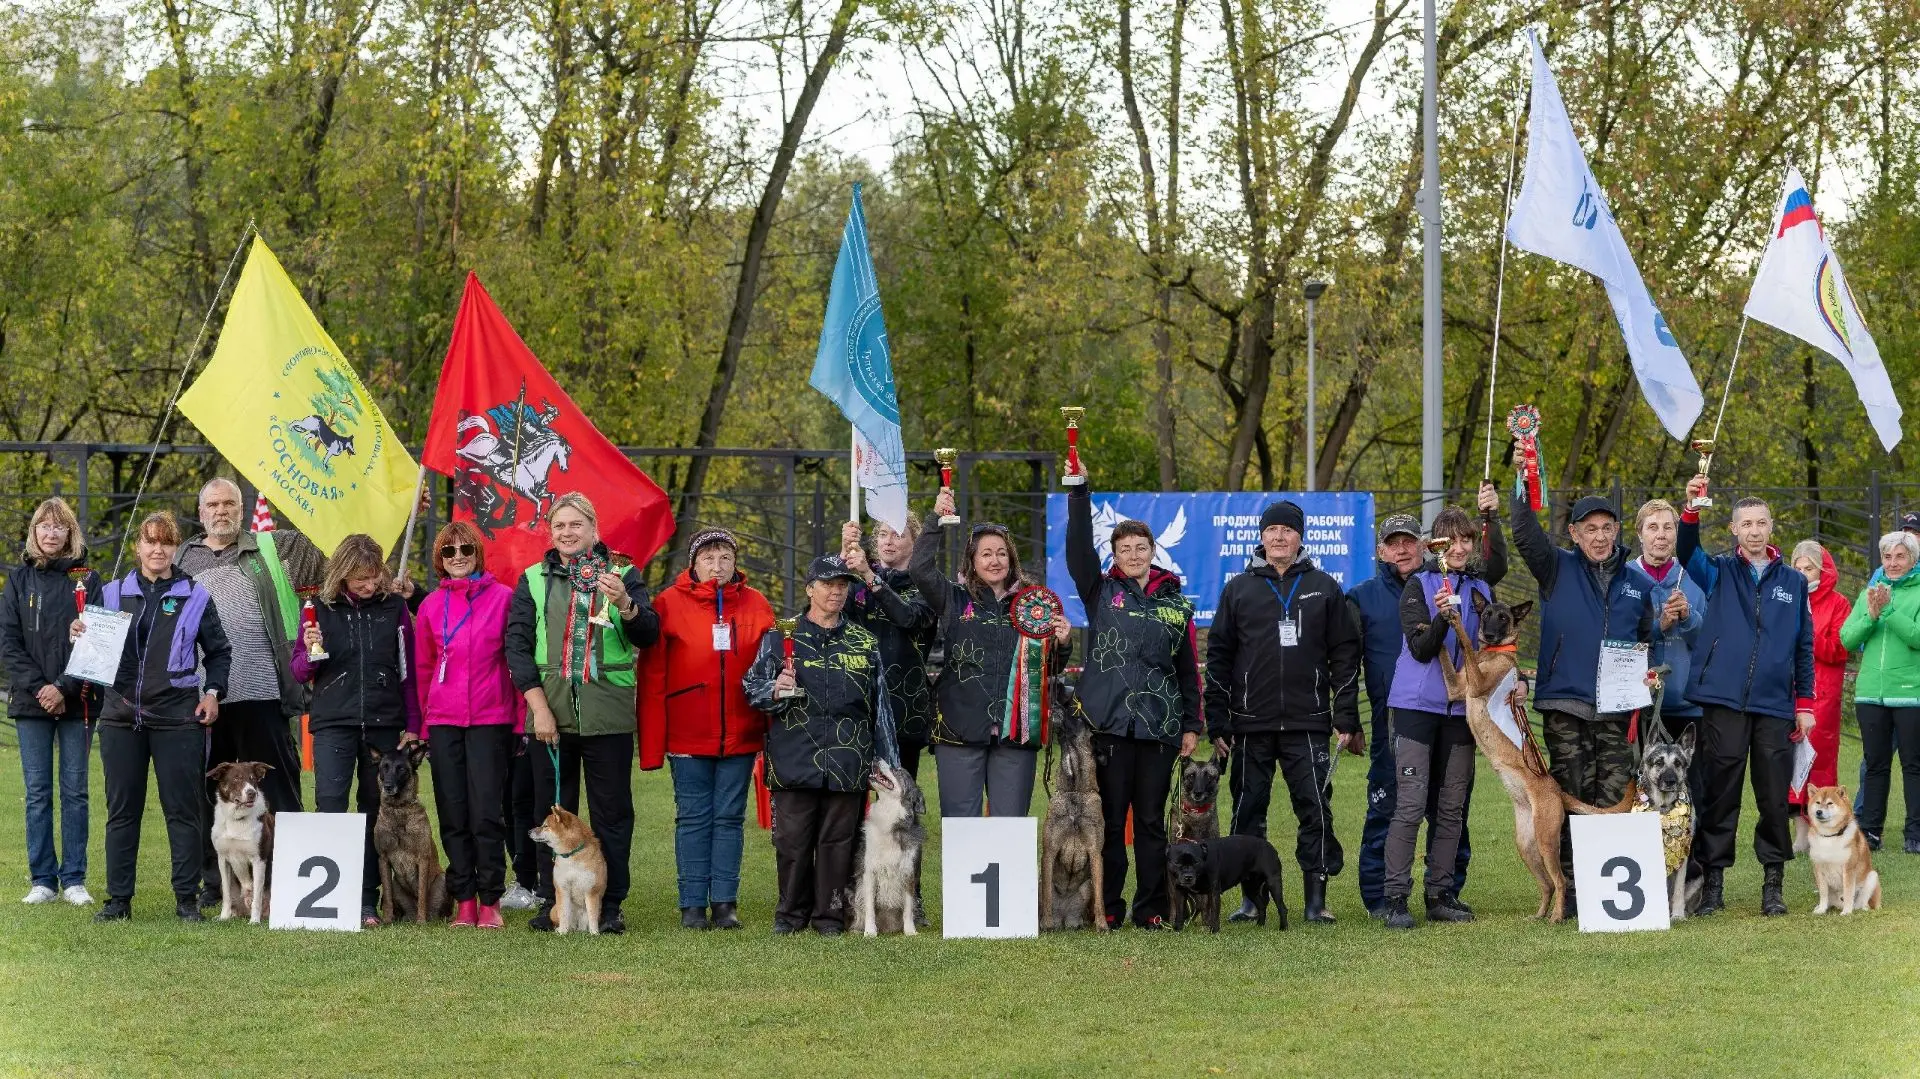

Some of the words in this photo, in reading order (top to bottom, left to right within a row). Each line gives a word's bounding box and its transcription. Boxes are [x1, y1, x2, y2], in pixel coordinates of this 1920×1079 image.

[271, 470, 315, 518] МОСКВА
[1227, 530, 1234, 541] И
[1307, 529, 1342, 541] СОБАК
[1306, 515, 1355, 527] РАБОЧИХ
[1219, 544, 1244, 557] ДЛЯ
[295, 856, 341, 919] 2
[970, 863, 1000, 928] 1
[1600, 856, 1645, 921] 3
